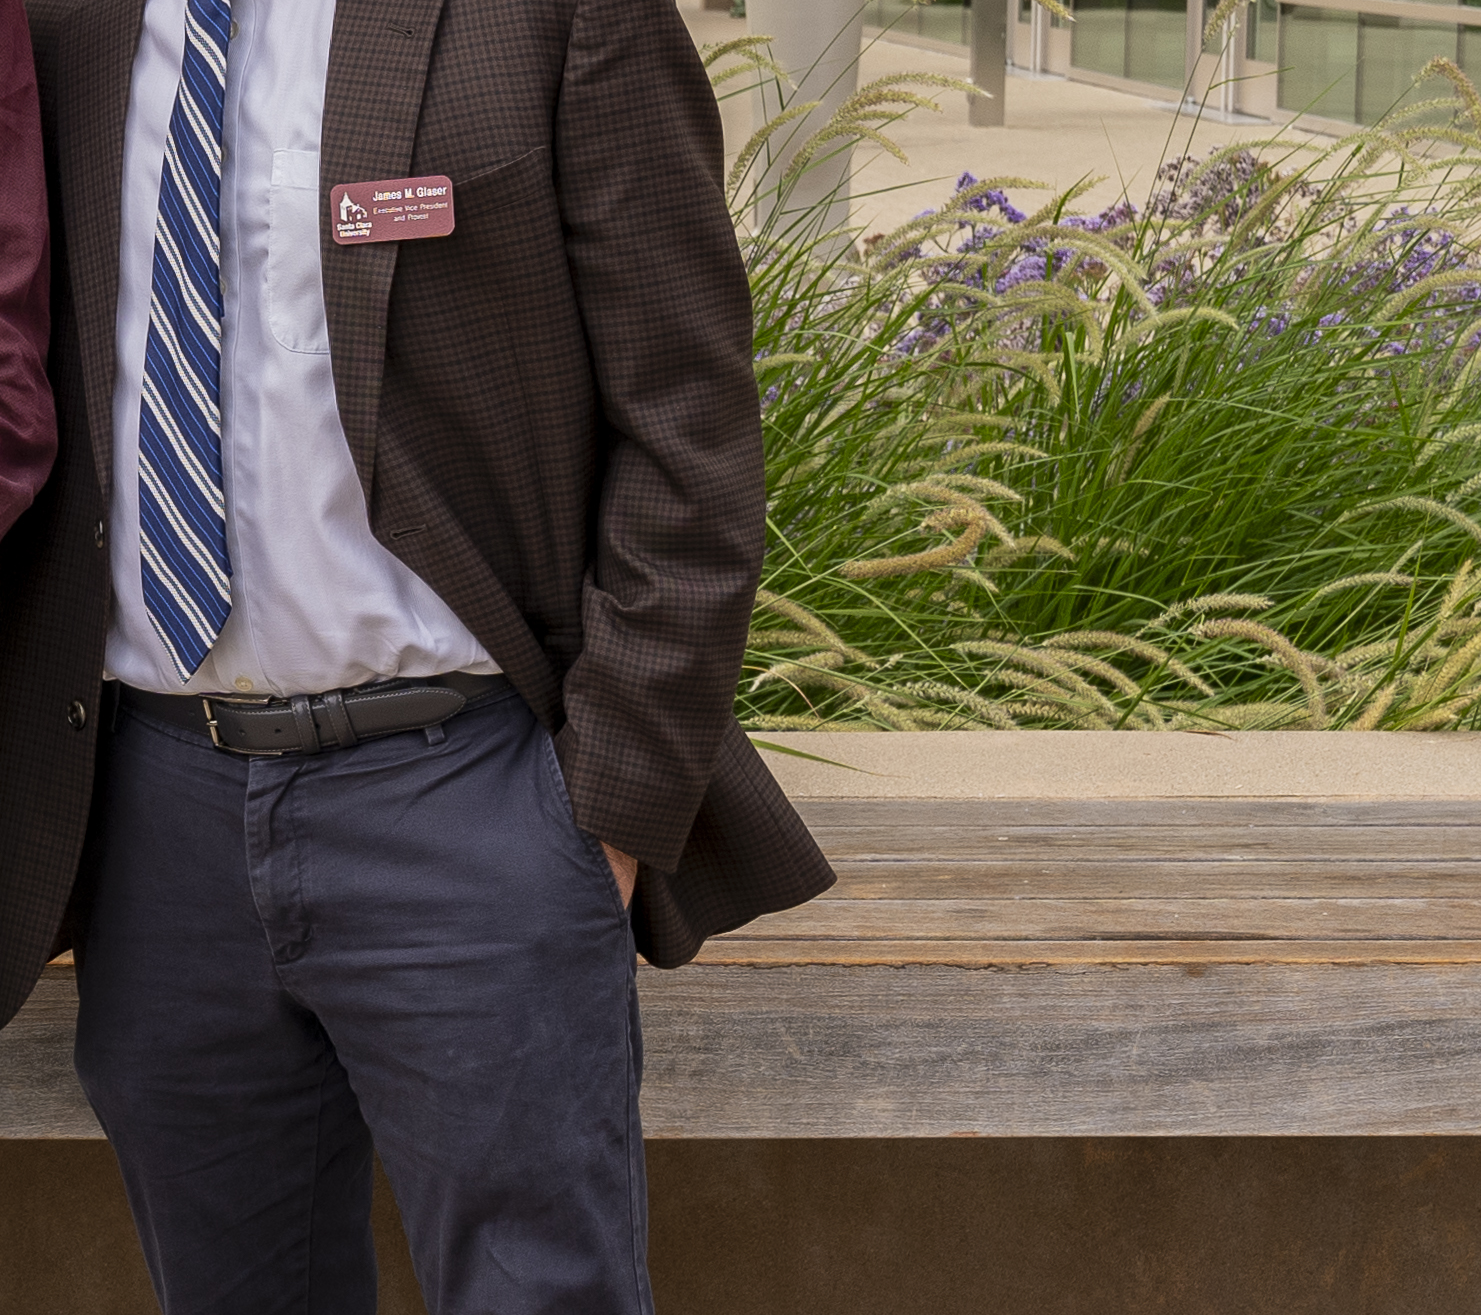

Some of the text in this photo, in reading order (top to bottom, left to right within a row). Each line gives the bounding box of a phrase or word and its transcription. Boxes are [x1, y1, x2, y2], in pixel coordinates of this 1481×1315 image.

[372, 187, 447, 201] James M. Glaser
